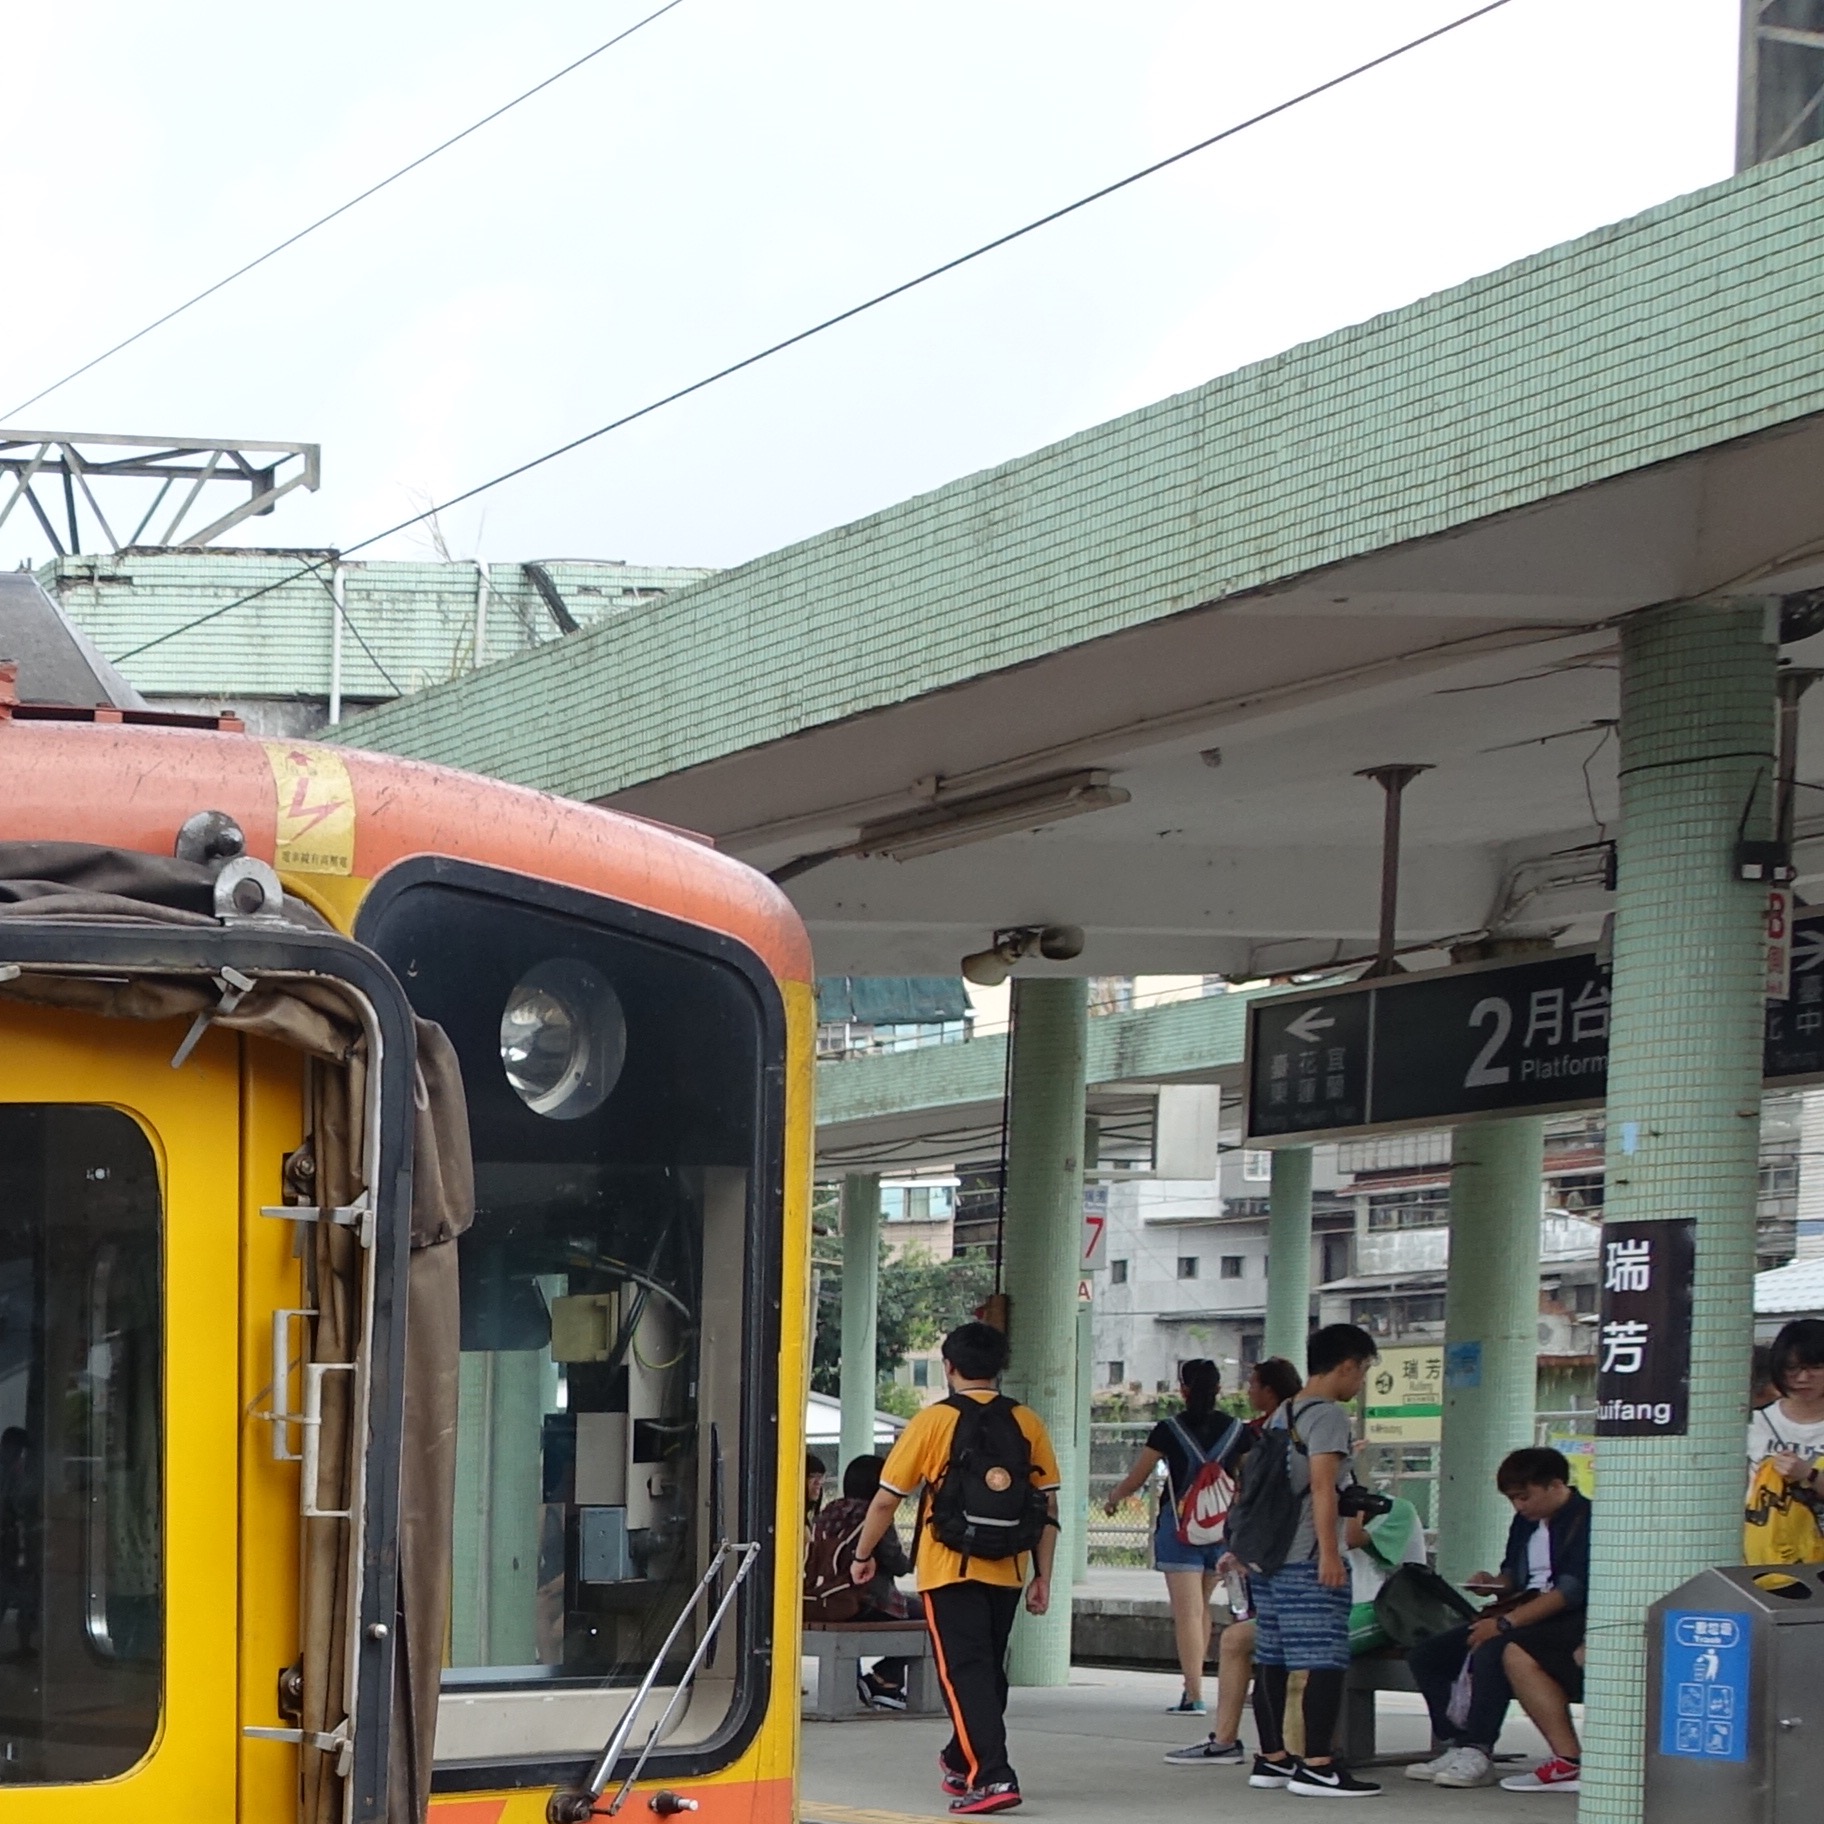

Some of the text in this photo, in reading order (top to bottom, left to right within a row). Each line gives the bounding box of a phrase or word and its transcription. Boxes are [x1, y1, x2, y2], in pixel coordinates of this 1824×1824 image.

[1522, 980, 1611, 1048] 月台
[1464, 996, 1513, 1089] 2
[1521, 1054, 1608, 1082] Platform
[1085, 1216, 1104, 1258] 7
[1079, 1281, 1091, 1300] A
[1601, 1238, 1651, 1373] 瑞芳
[1403, 1358, 1442, 1380] 瑞芳
